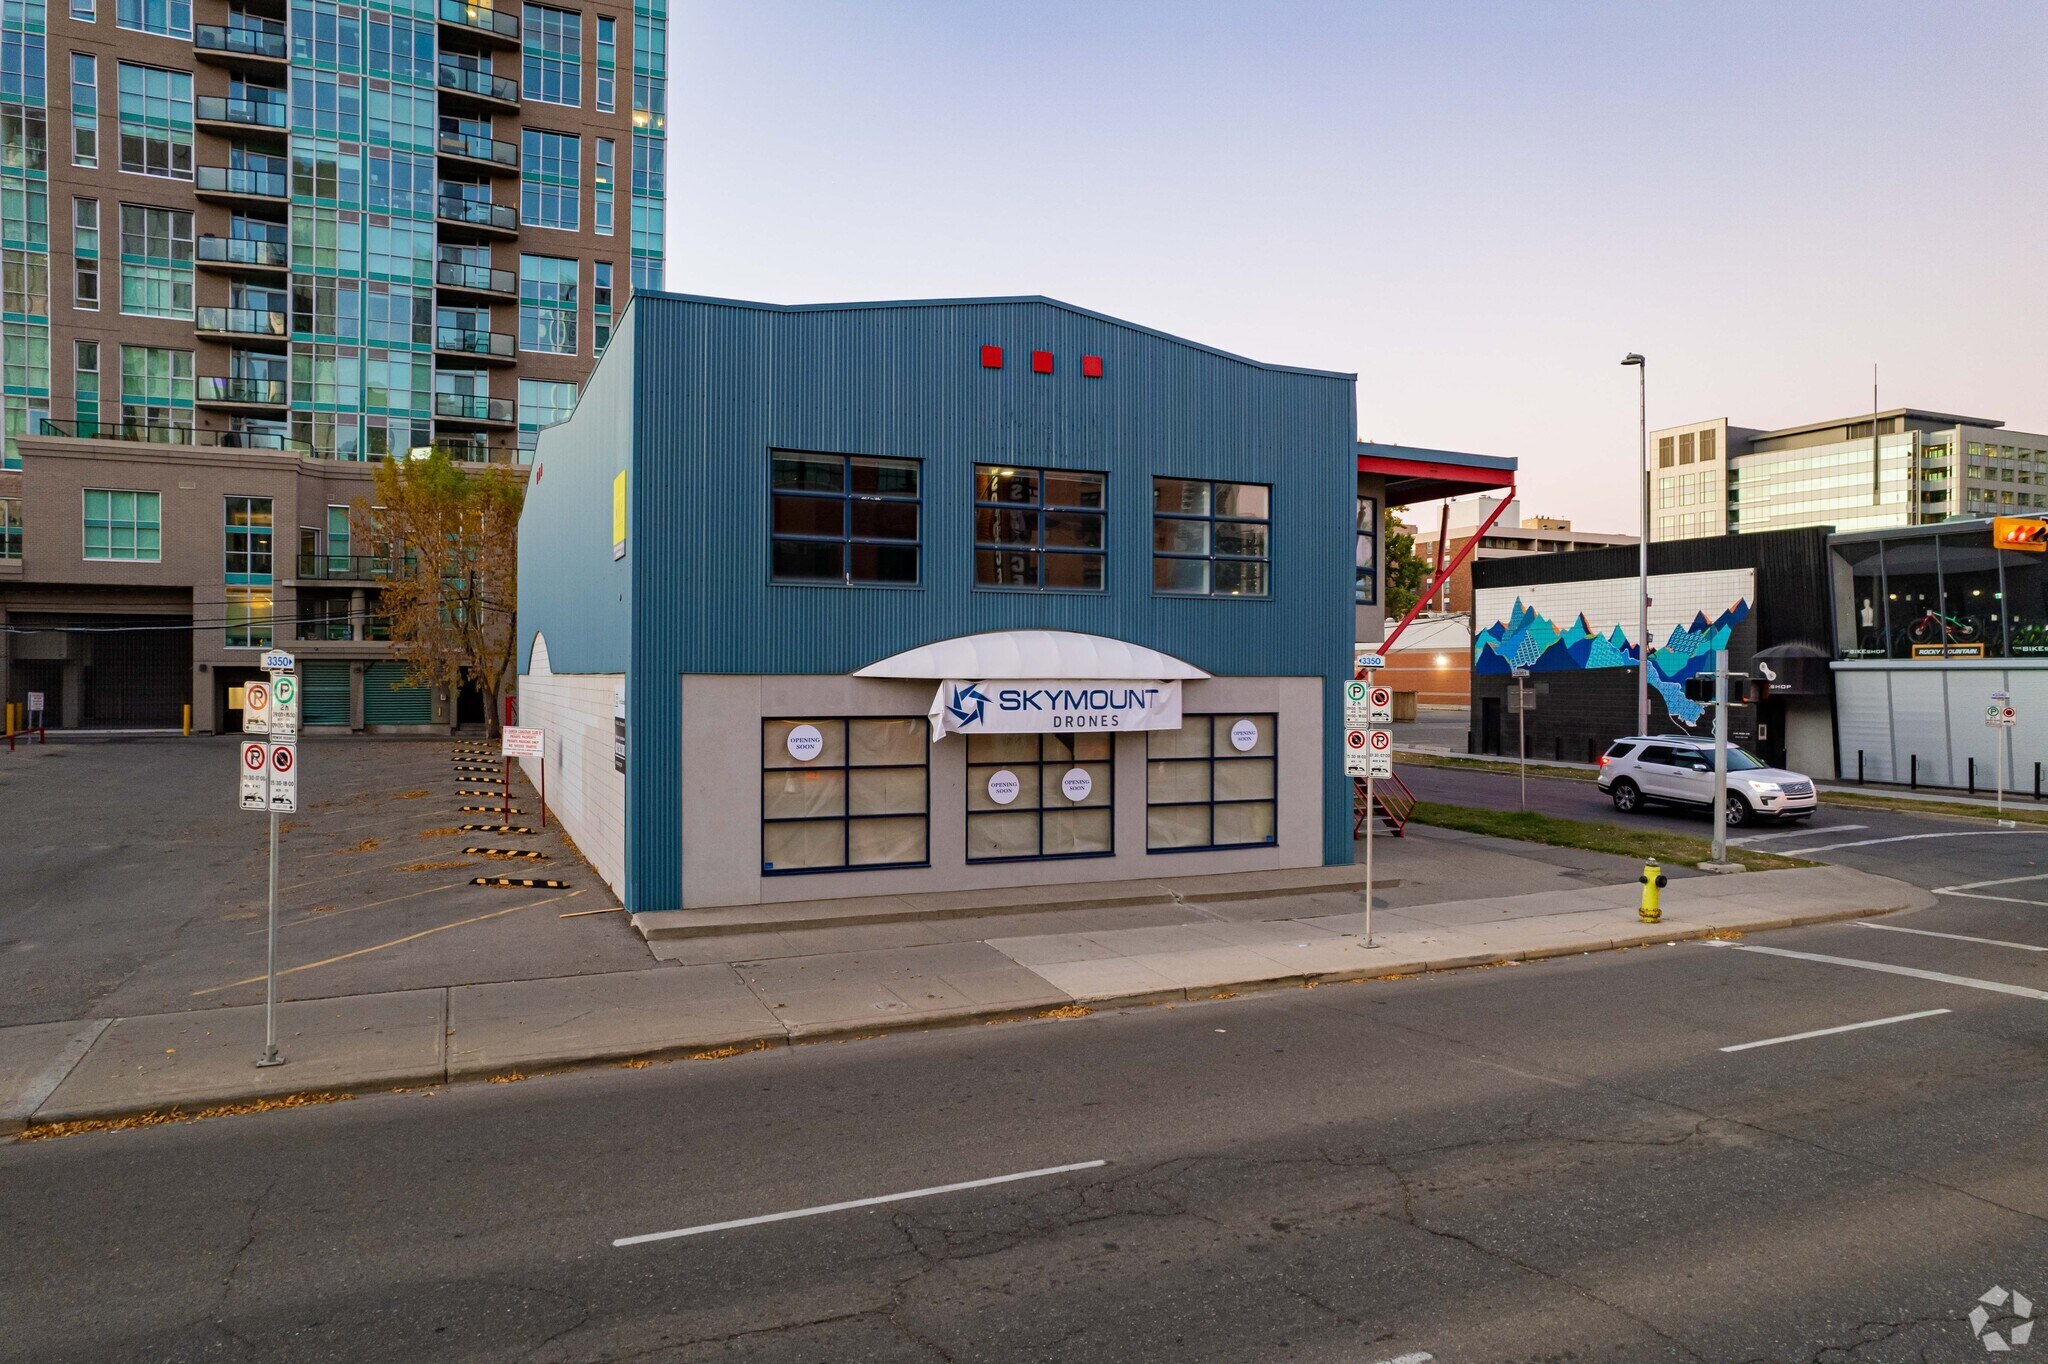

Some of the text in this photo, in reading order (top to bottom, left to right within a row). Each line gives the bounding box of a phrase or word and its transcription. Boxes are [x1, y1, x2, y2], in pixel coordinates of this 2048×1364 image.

[267, 656, 288, 667] 3350
[1362, 657, 1381, 665] 3350
[999, 688, 1159, 711] SKYMOUNT
[1053, 715, 1119, 728] DRONES
